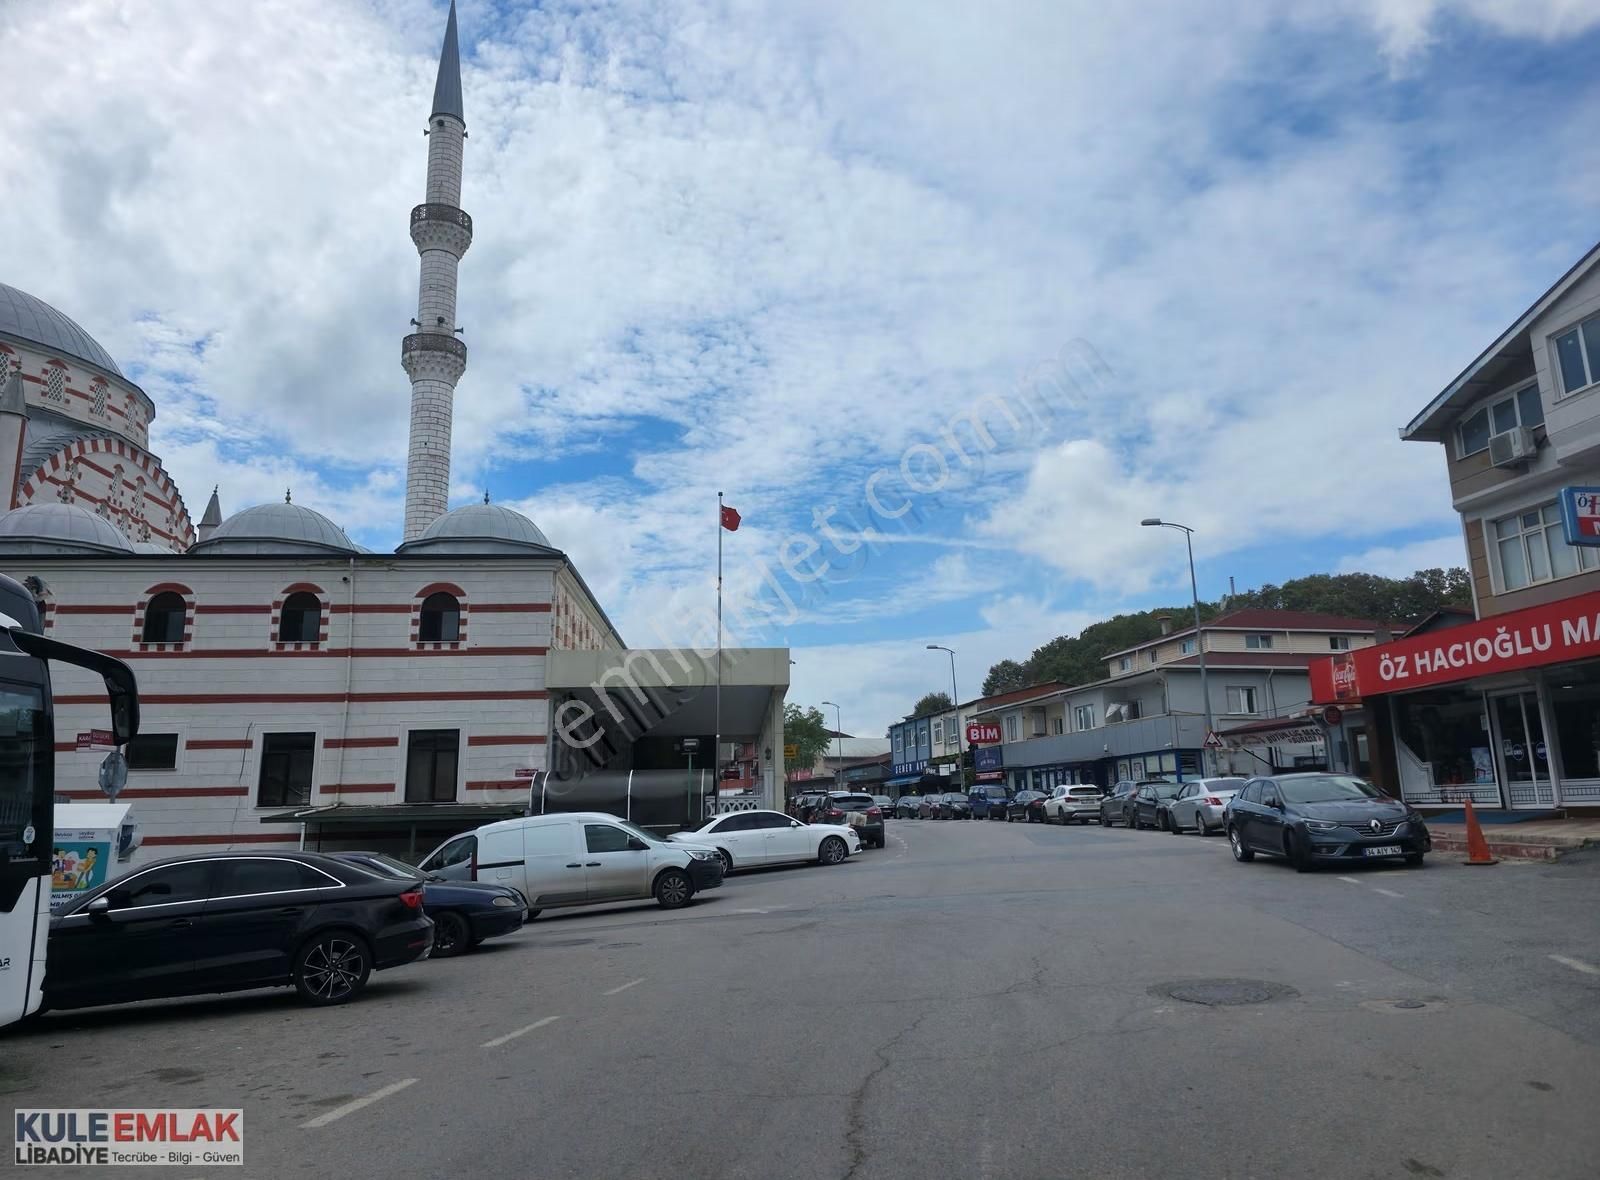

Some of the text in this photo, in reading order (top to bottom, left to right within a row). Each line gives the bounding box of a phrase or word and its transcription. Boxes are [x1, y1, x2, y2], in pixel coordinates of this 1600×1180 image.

[1379, 654, 1409, 681] ÖZ
[1414, 624, 1553, 675] HACIOĞLU
[970, 726, 998, 740] BİM
